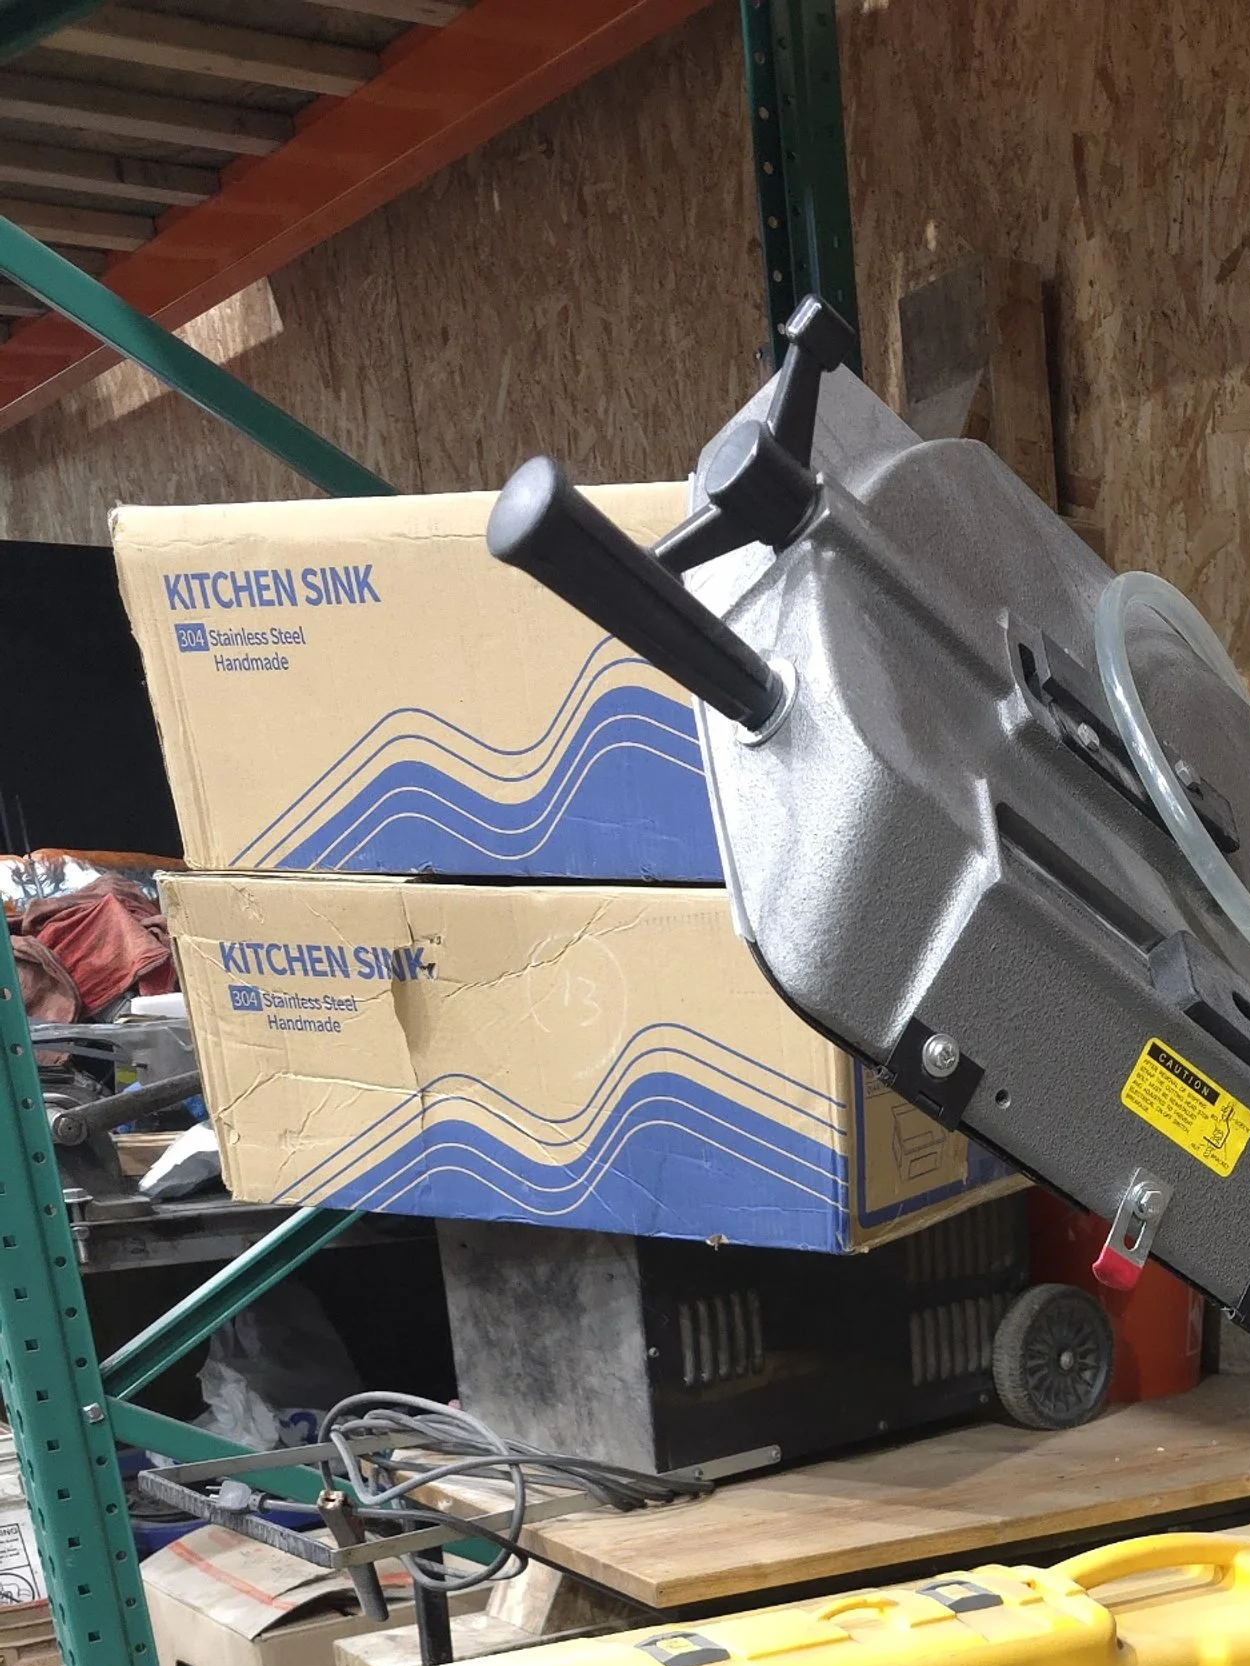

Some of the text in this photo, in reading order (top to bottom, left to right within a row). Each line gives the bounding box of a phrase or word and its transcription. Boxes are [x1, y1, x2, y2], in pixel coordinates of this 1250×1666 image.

[163, 563, 382, 611] KITCHEN SINK
[178, 625, 306, 648] 304 Stainless Steel
[214, 651, 290, 673] Handmade
[219, 941, 437, 982] KITCHEN SINK
[231, 988, 359, 1013] 304 Stainless Steel
[267, 1014, 342, 1034] Handmade
[1157, 1051, 1211, 1097] CAUTION
